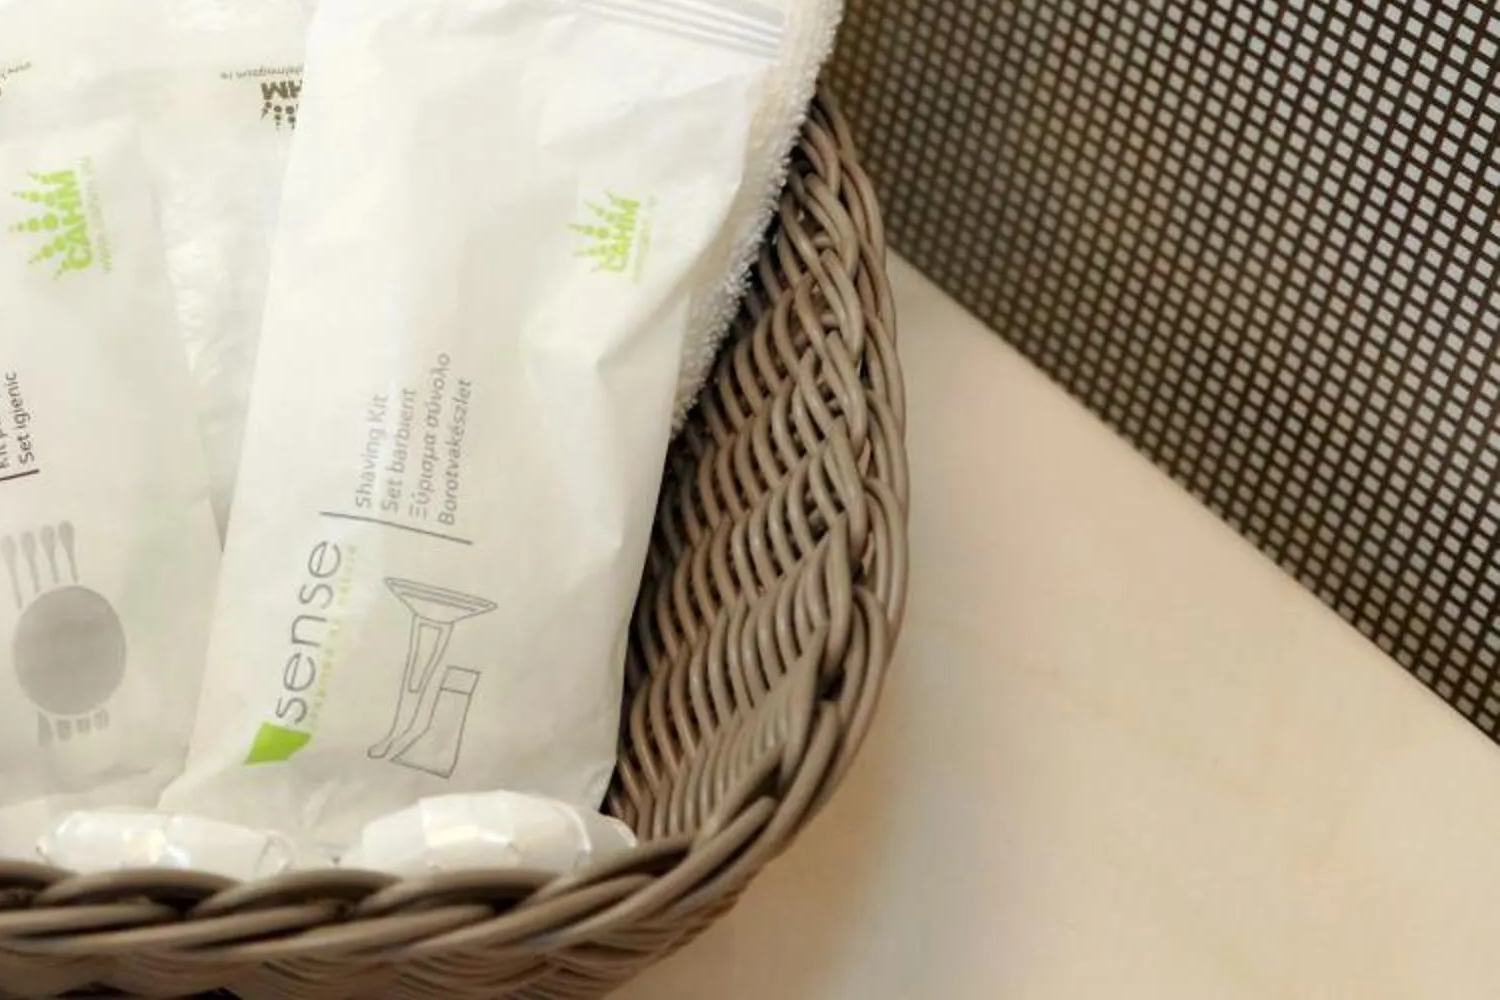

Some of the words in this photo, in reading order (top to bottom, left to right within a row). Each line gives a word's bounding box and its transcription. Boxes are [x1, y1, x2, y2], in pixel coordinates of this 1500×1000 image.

[5, 371, 31, 430] igienic
[367, 394, 389, 423] Kit
[17, 433, 35, 465] Set
[355, 428, 387, 509] Shaving
[380, 478, 403, 513] Set
[275, 540, 341, 725] sense
